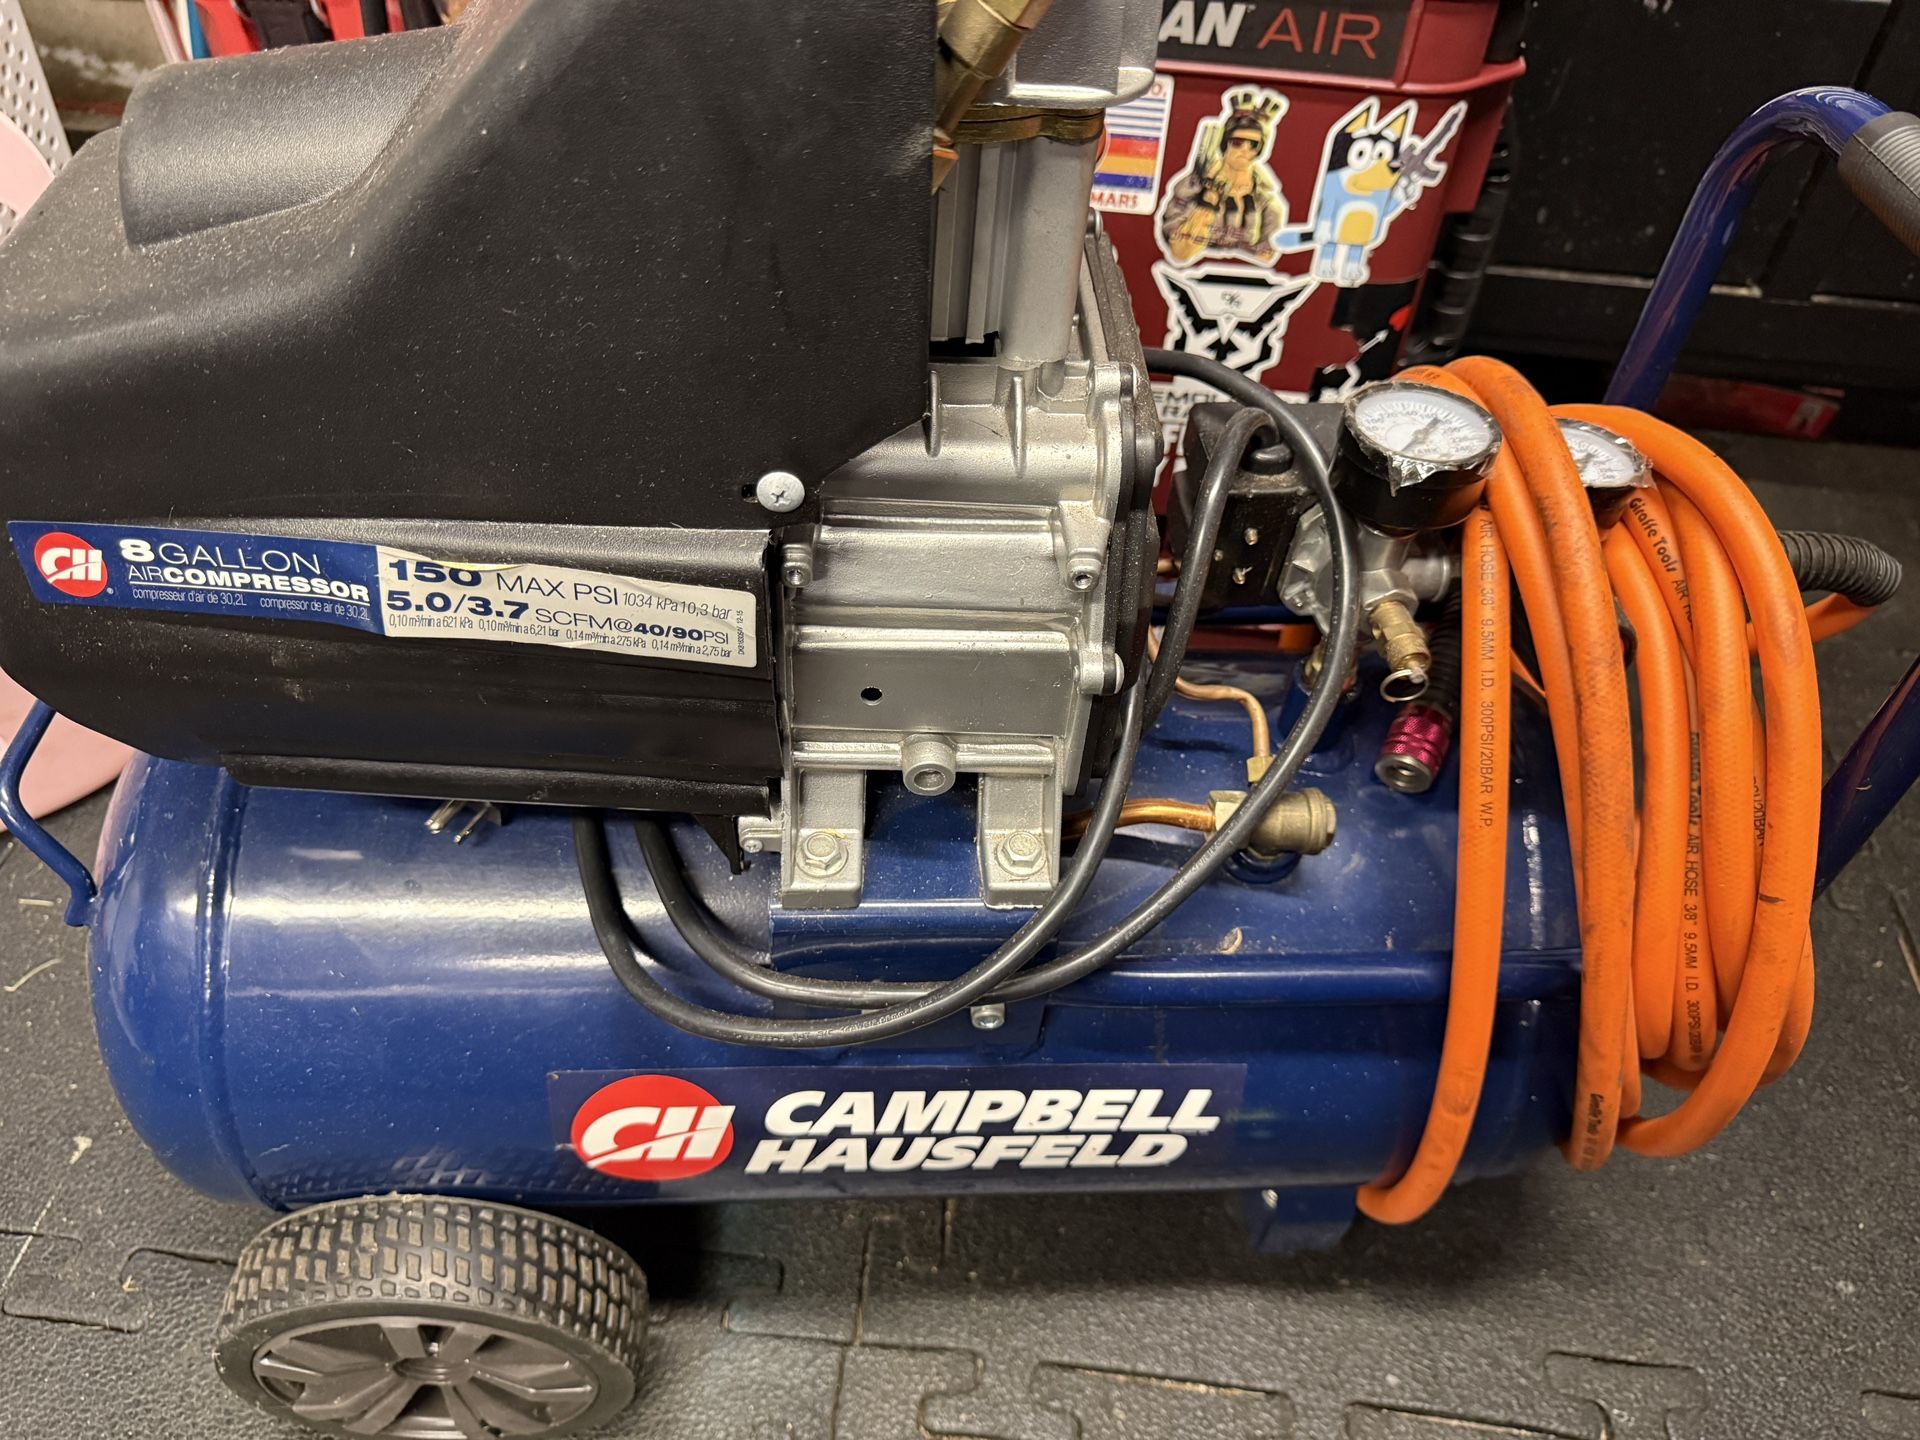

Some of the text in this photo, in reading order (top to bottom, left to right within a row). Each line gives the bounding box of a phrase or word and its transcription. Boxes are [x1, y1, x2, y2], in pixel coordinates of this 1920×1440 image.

[1257, 8, 1382, 59] AIR
[1479, 518, 1494, 540] AIR
[41, 547, 103, 584] CH
[119, 538, 321, 575] 8 GALLON
[1480, 544, 1495, 581] HOSE
[1629, 497, 1659, 538] Giraffe
[1652, 536, 1679, 573] Tools
[1671, 578, 1690, 601] AIR
[128, 564, 371, 602] AIRCOMPRESSOR
[132, 588, 248, 607] compresseur d'air de 30,2L
[388, 559, 733, 621] 150 MAX PSI 1034 kPa 10,3 bar
[260, 597, 310, 612] compressor
[310, 600, 322, 612] de
[323, 601, 333, 613] air
[334, 603, 346, 616] de
[386, 590, 530, 620] 5.0/3.7
[389, 613, 408, 629] 0,10
[436, 619, 442, 628] a
[442, 615, 458, 629] 621
[459, 616, 474, 630] kPa
[478, 618, 497, 633] 0,10
[523, 625, 529, 635] a
[529, 623, 547, 637] 6,21
[548, 626, 561, 638] bar
[565, 629, 584, 642] 0,14
[610, 636, 616, 645] a
[616, 634, 631, 648] 275
[632, 635, 647, 648] kPa
[651, 638, 670, 651] 0,14
[695, 646, 701, 655] a
[701, 644, 720, 657] 2,75
[720, 647, 733, 658] bar
[1480, 618, 1495, 660] 9.5MM
[1480, 669, 1495, 691] I.D.
[1479, 801, 1495, 828] W.P.
[1686, 833, 1700, 855] AIR
[1684, 860, 1698, 897] HOSE
[1683, 932, 1698, 969] 9.5MM
[764, 1088, 1221, 1136] CAMPBELL
[581, 1104, 737, 1170] CH
[743, 1133, 1190, 1175] HAUSFELD
